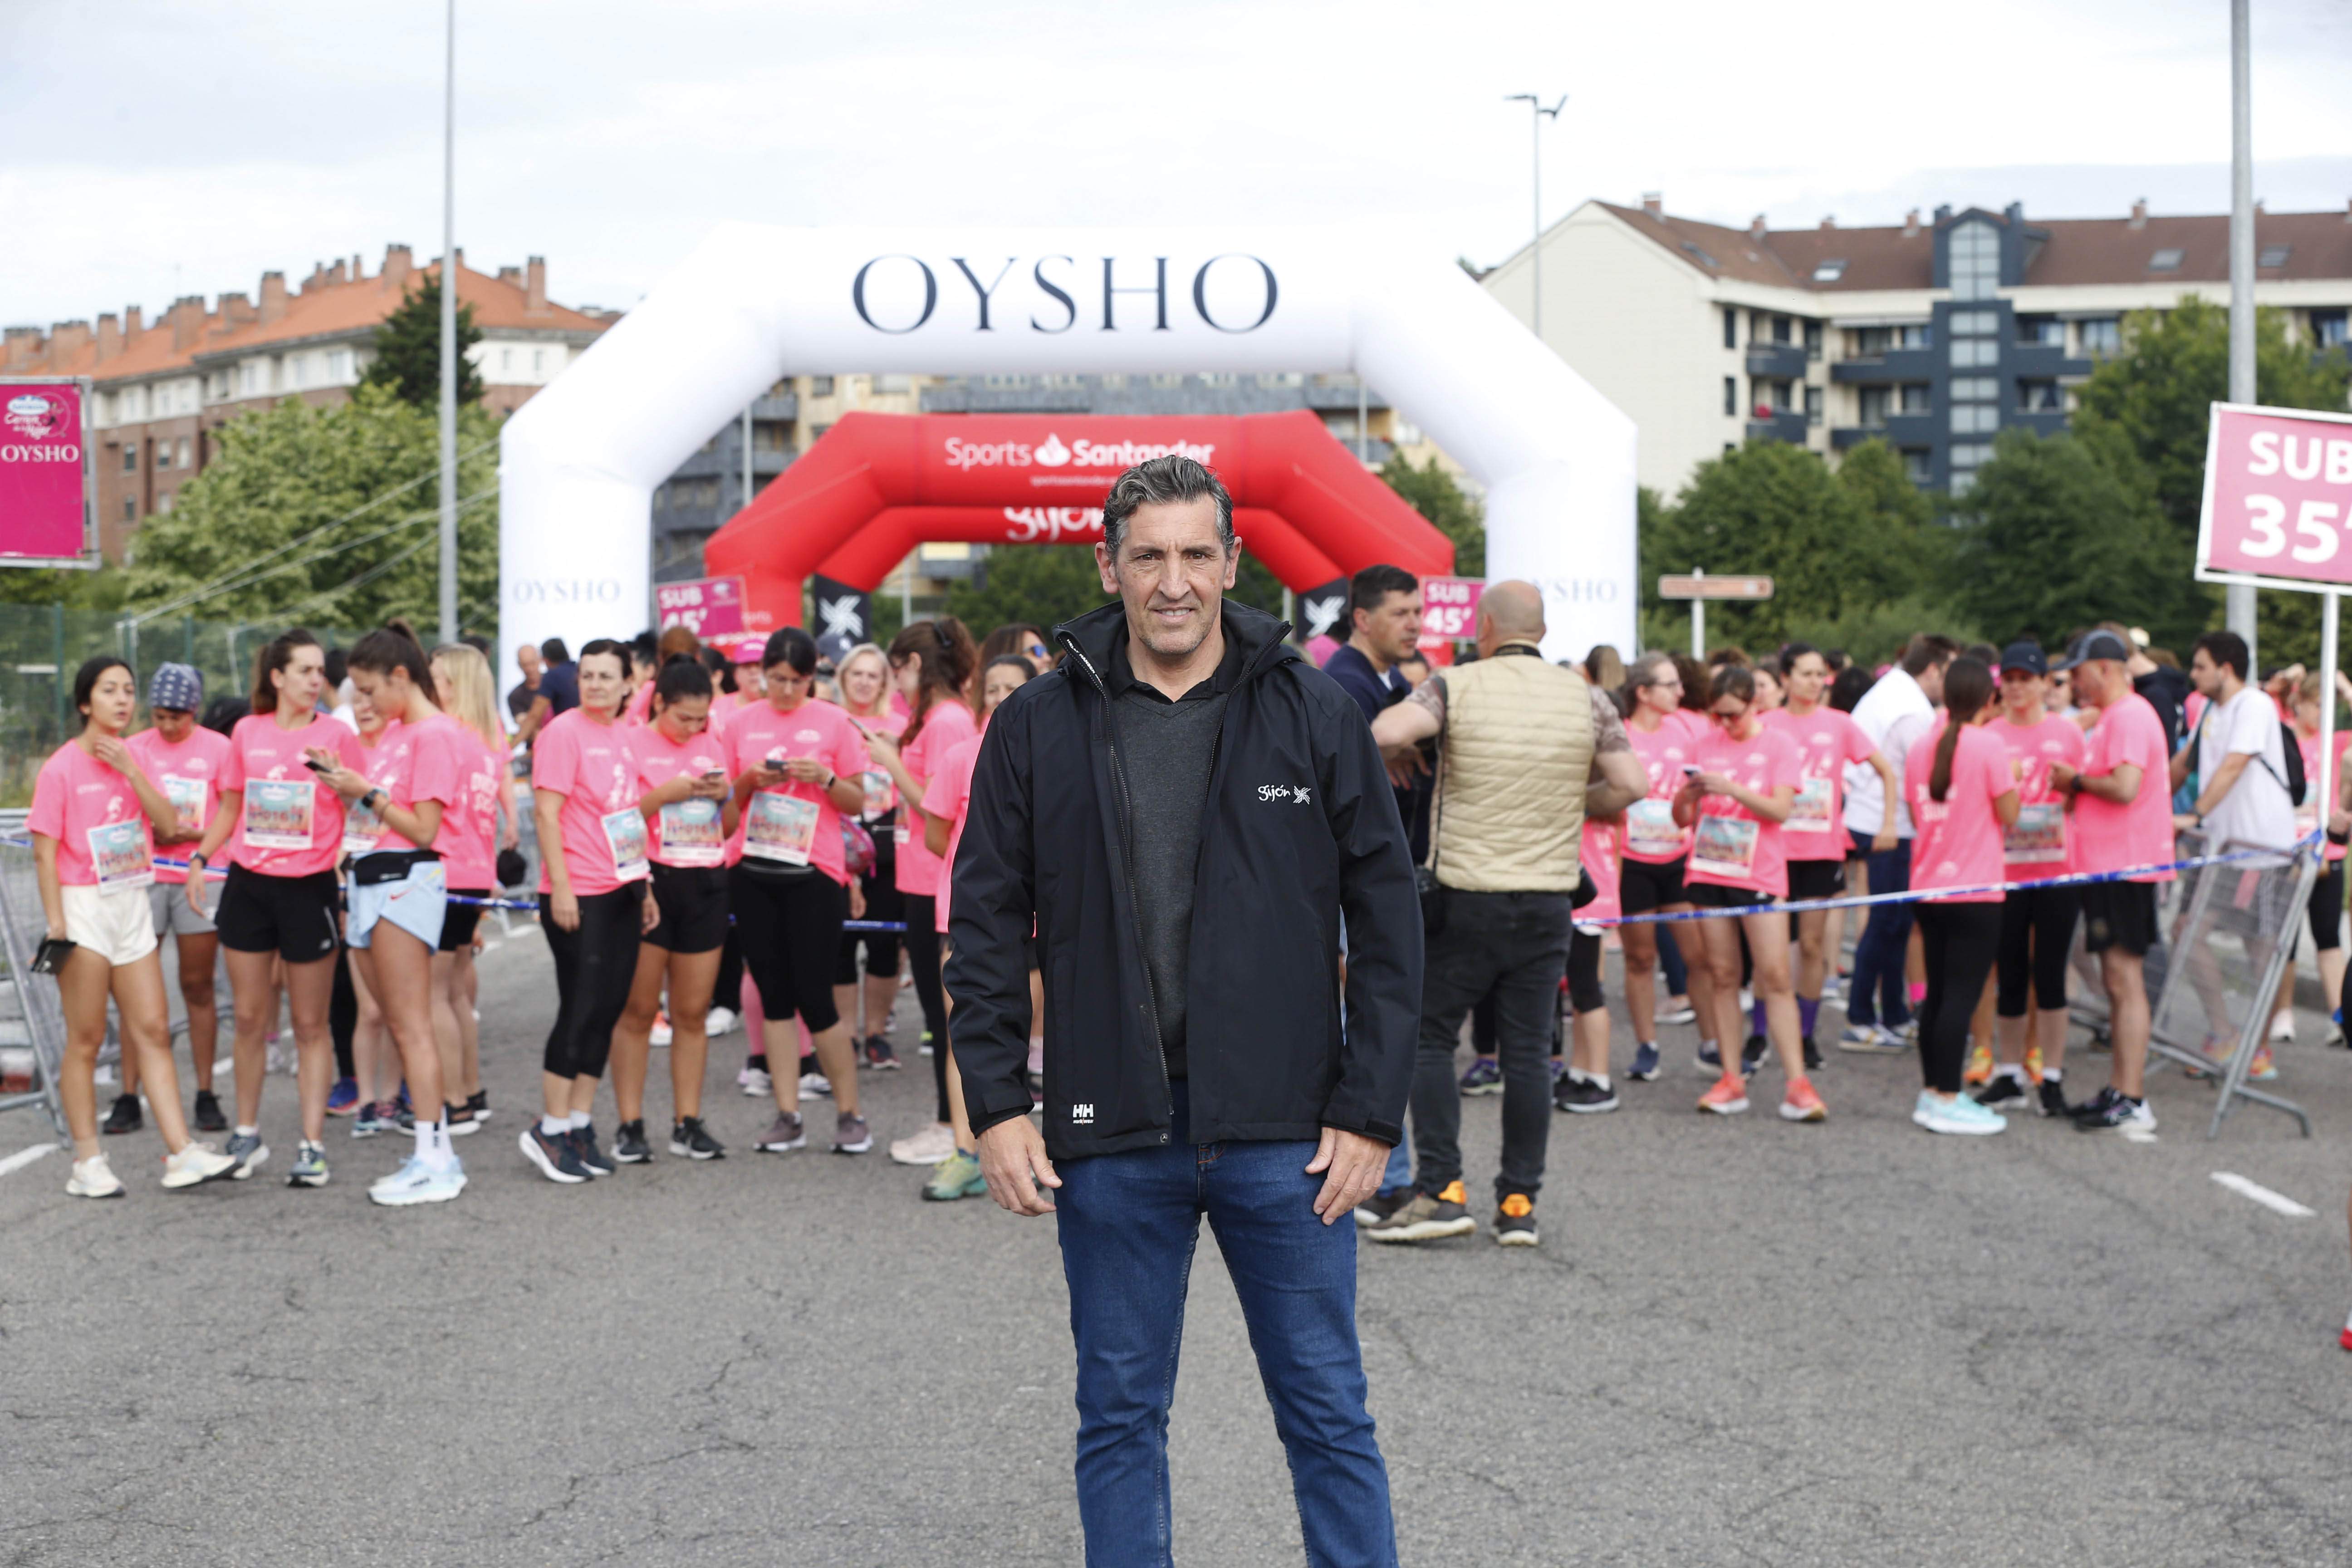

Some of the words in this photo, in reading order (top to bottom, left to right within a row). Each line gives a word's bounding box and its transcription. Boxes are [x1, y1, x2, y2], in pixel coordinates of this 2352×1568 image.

[852, 252, 1279, 335] OYSHO
[0, 444, 79, 463] OYSHO
[945, 436, 1033, 472] Sports
[1072, 438, 1215, 466] Santander
[2247, 430, 2352, 484] SUB
[512, 578, 621, 605] OYSHO
[660, 586, 703, 609] SUB
[1426, 583, 1470, 604] SUB
[1532, 578, 1619, 603] YSHO
[1258, 784, 1291, 802] gijón
[1073, 1103, 1094, 1118] HH
